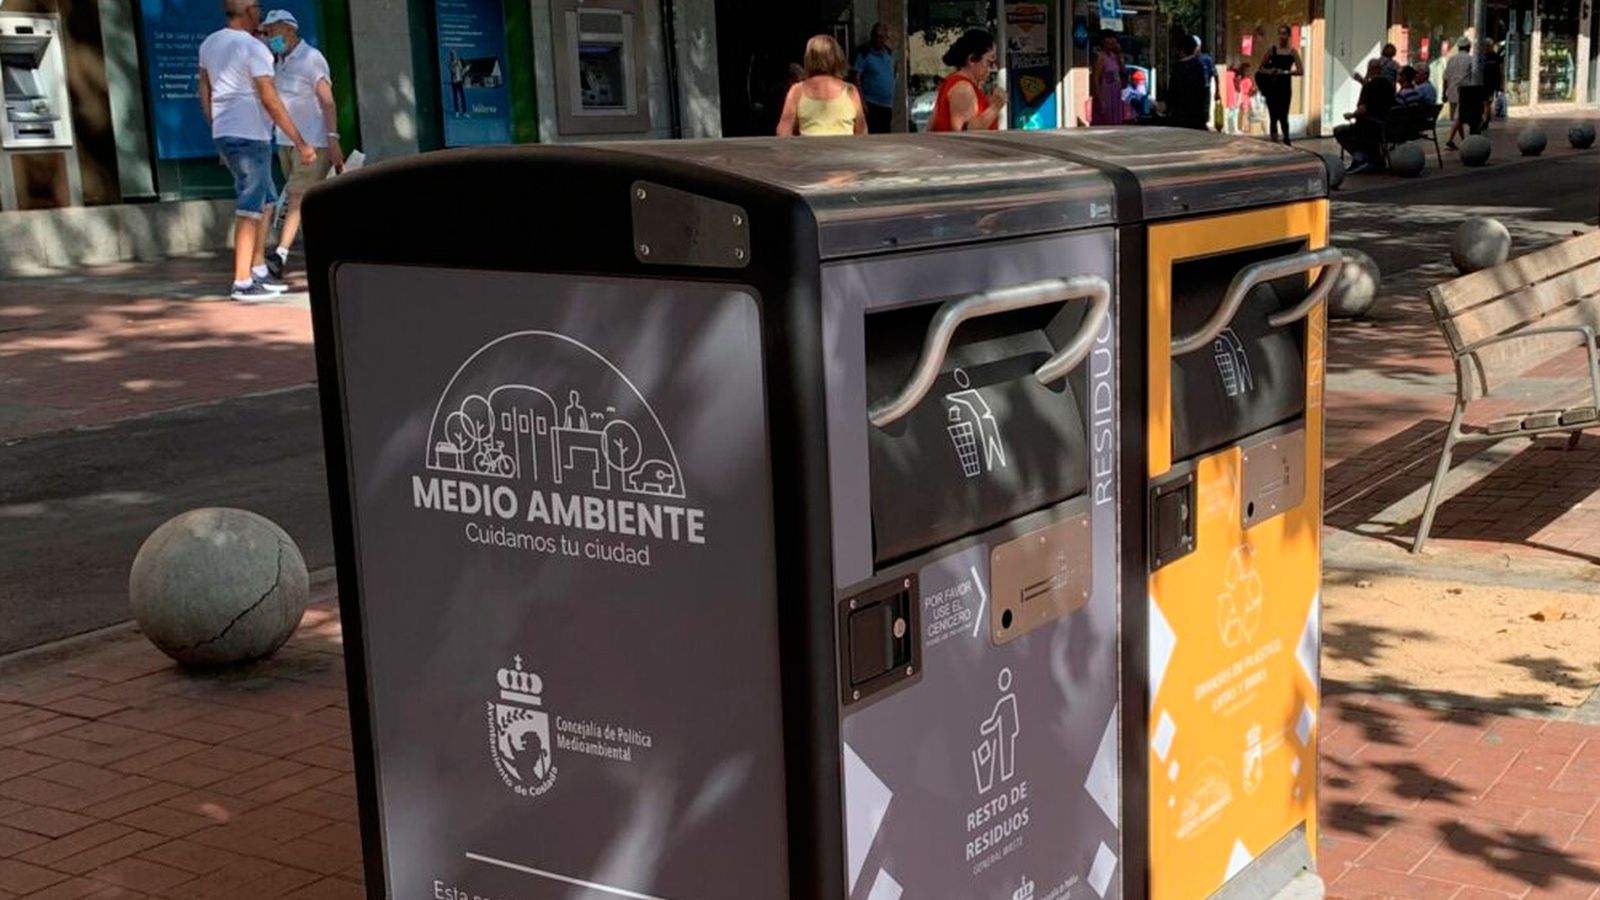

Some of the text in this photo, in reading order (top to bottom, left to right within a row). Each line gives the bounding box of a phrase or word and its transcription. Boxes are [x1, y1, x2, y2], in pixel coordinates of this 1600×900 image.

[411, 475, 706, 544] MEDIO AMBIENTE
[465, 522, 650, 566] Cuidamos tu ciudad
[925, 580, 972, 609] POR FAVOR
[933, 600, 963, 620] USE EL
[928, 609, 971, 637] CENICERO
[486, 701, 513, 787] Ayuntamiento
[514, 784, 527, 796] de
[556, 733, 632, 762] Medioambiental
[604, 725, 616, 741] de
[967, 781, 1028, 832] RESTO DE
[966, 807, 1030, 861] RESIDUOS
